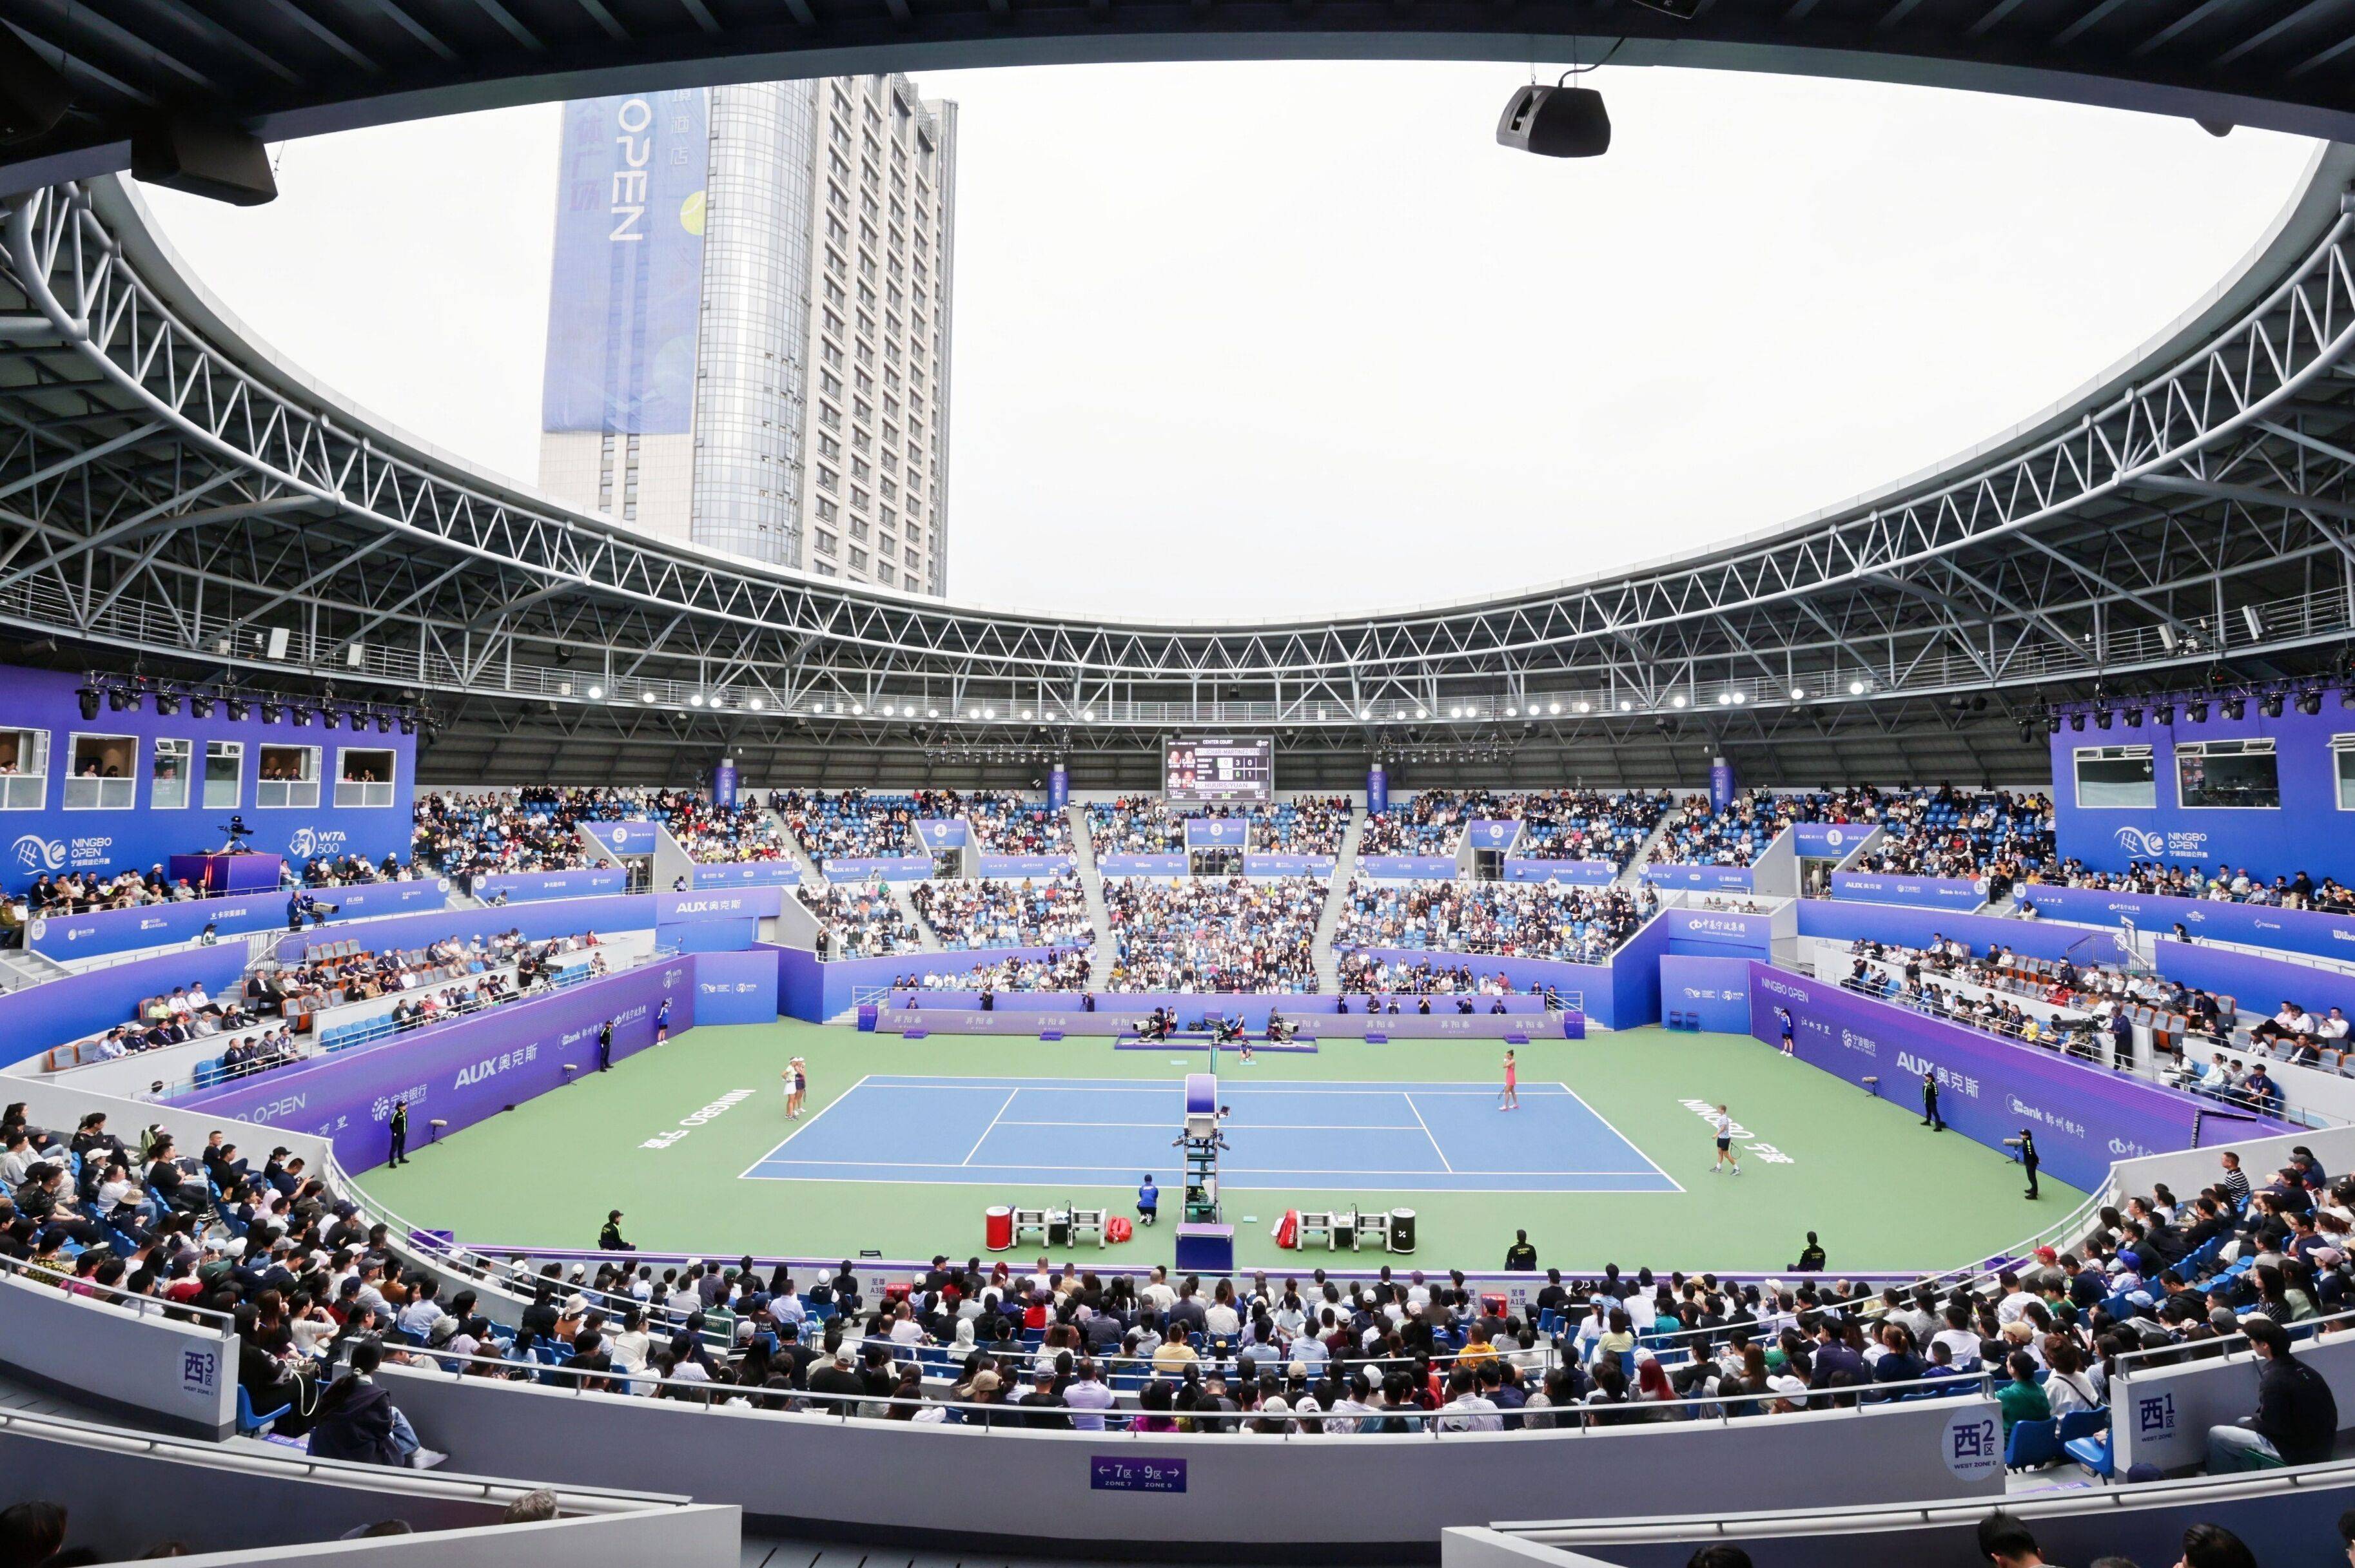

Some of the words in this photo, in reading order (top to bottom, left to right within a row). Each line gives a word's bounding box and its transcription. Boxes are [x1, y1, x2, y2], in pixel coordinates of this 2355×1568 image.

[609, 99, 652, 241] OPEN
[318, 831, 347, 842] WTA
[617, 830, 623, 839] 5
[937, 826, 944, 835] 4
[2168, 832, 2207, 842] NINGBO
[72, 837, 112, 848] NINGBO
[1832, 833, 1838, 842] 1
[317, 843, 340, 854] 500
[2169, 841, 2198, 849] OPEN
[71, 847, 101, 858] OPEN
[676, 902, 708, 913] AUX
[708, 899, 741, 910] 奥克斯
[1703, 920, 1745, 933] 中基宁波集团
[672, 969, 682, 978] WTA
[1761, 977, 1786, 996] NINGBO
[1788, 988, 1809, 1003] OPEN
[1852, 1033, 1876, 1052] 宁波银行
[454, 1057, 500, 1090] AUX
[498, 1043, 538, 1074] 奥克斯
[1896, 1050, 1935, 1078] AUX
[1936, 1067, 1979, 1099] 奥克斯
[390, 1083, 427, 1108] 宁波银行
[255, 1093, 306, 1124] OPEN
[679, 1089, 757, 1126] NINGBO
[2046, 1110, 2086, 1139] 鄞州银行
[1115, 1464, 1132, 1478] 7区
[1144, 1466, 1162, 1480] 9区
